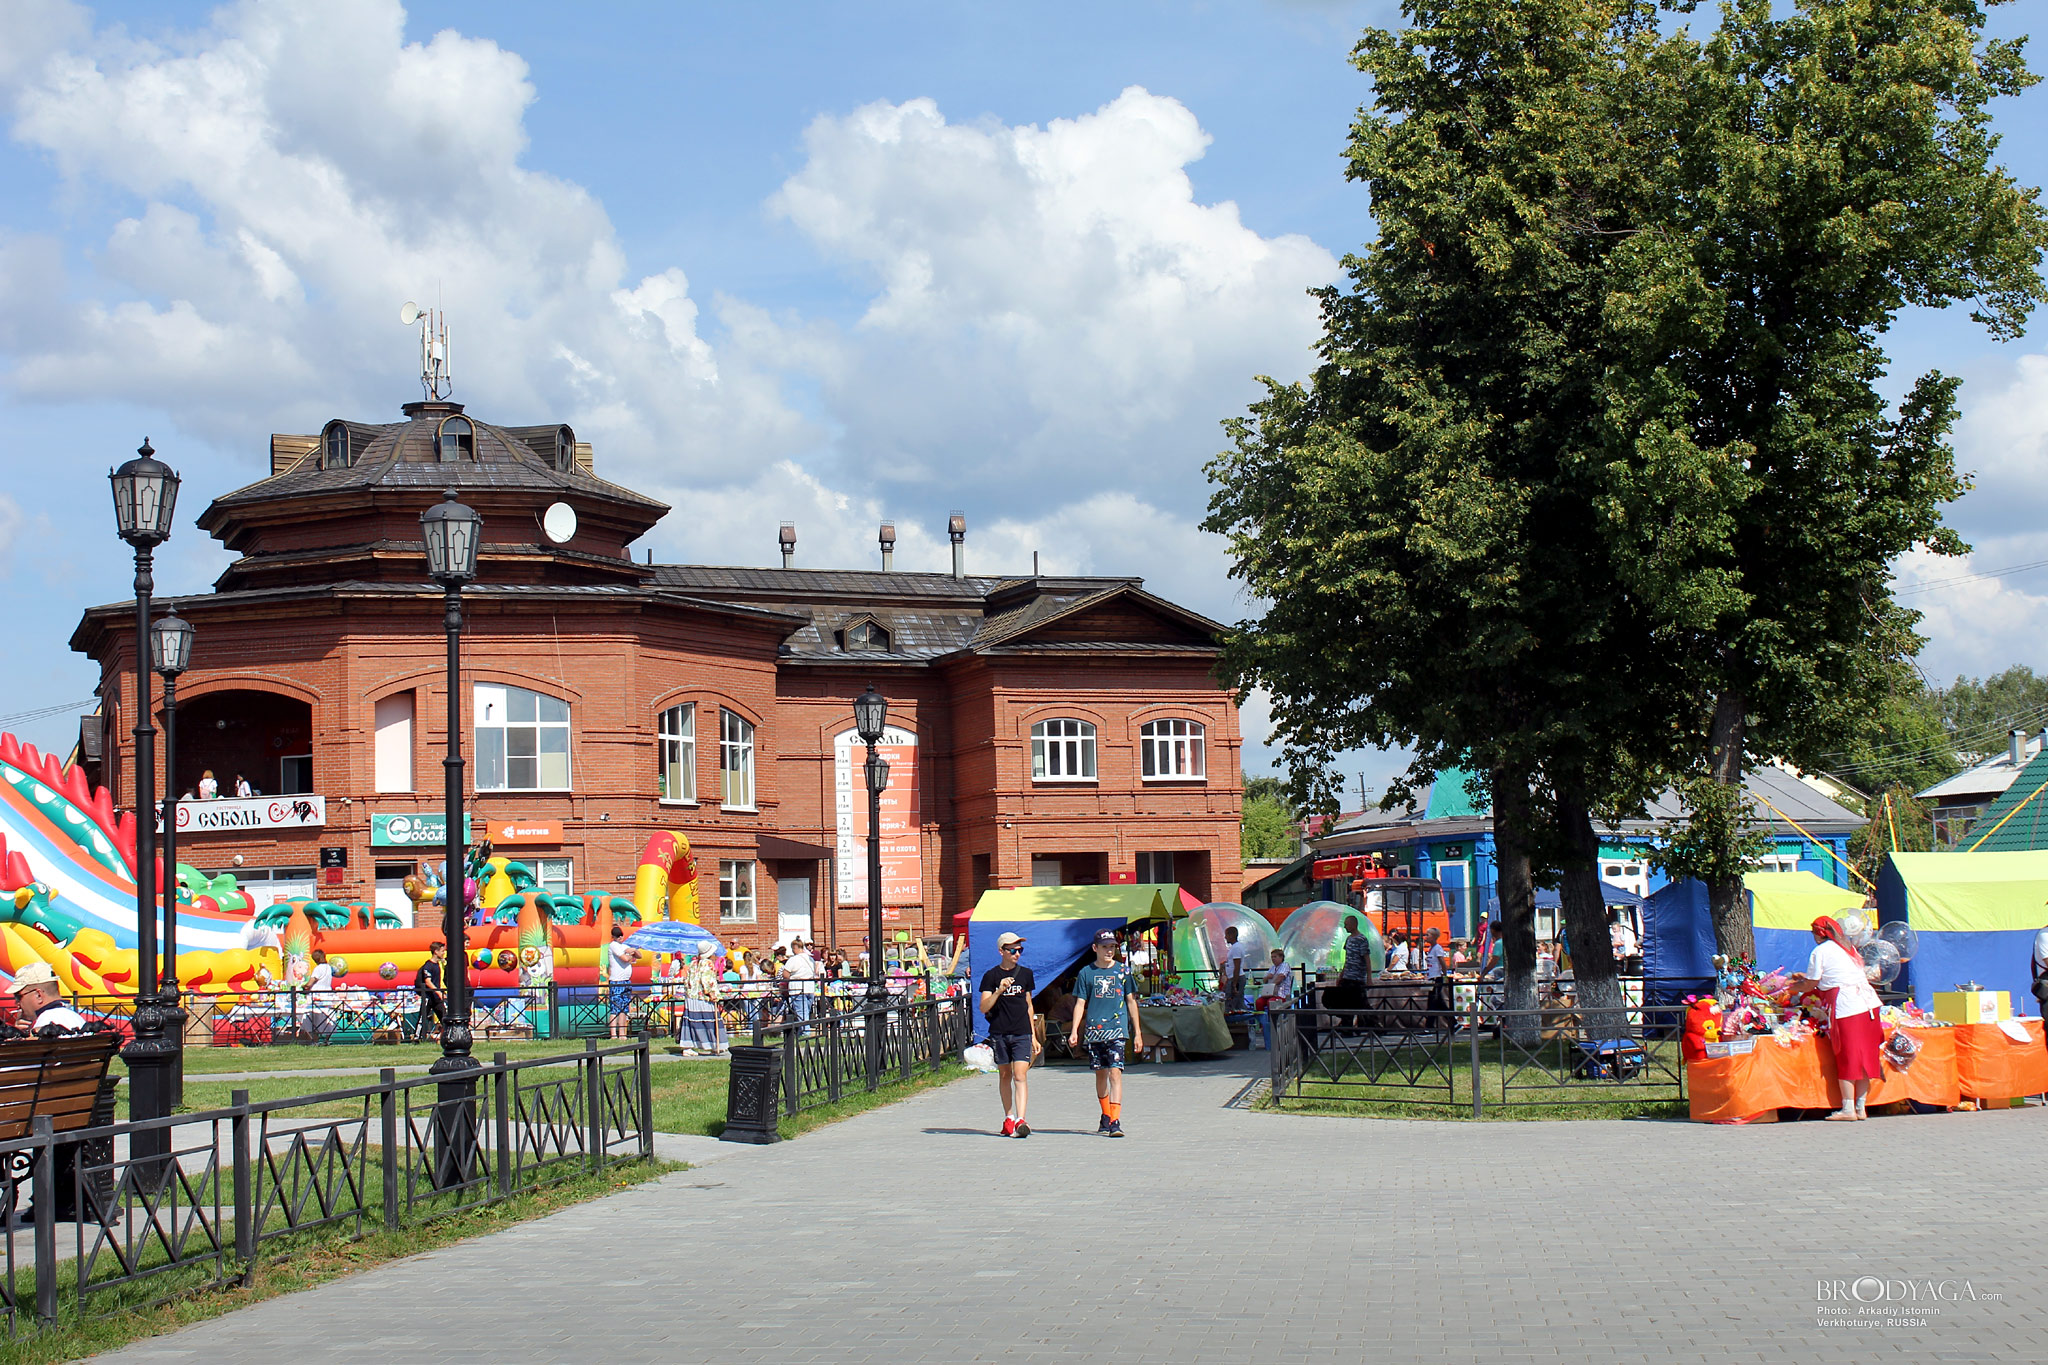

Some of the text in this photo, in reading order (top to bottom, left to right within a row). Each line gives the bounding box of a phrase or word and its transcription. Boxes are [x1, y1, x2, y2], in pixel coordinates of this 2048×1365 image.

[849, 735, 904, 745] СОЛЬ
[199, 810, 261, 828] СОБОЛЬ
[842, 817, 847, 825] 2
[386, 816, 447, 844] Собол
[430, 823, 447, 831] каф
[866, 821, 906, 831] ерия-2
[843, 840, 847, 848] 2
[843, 862, 848, 870] 2
[843, 885, 848, 894] 2
[858, 885, 917, 895] OFLAME
